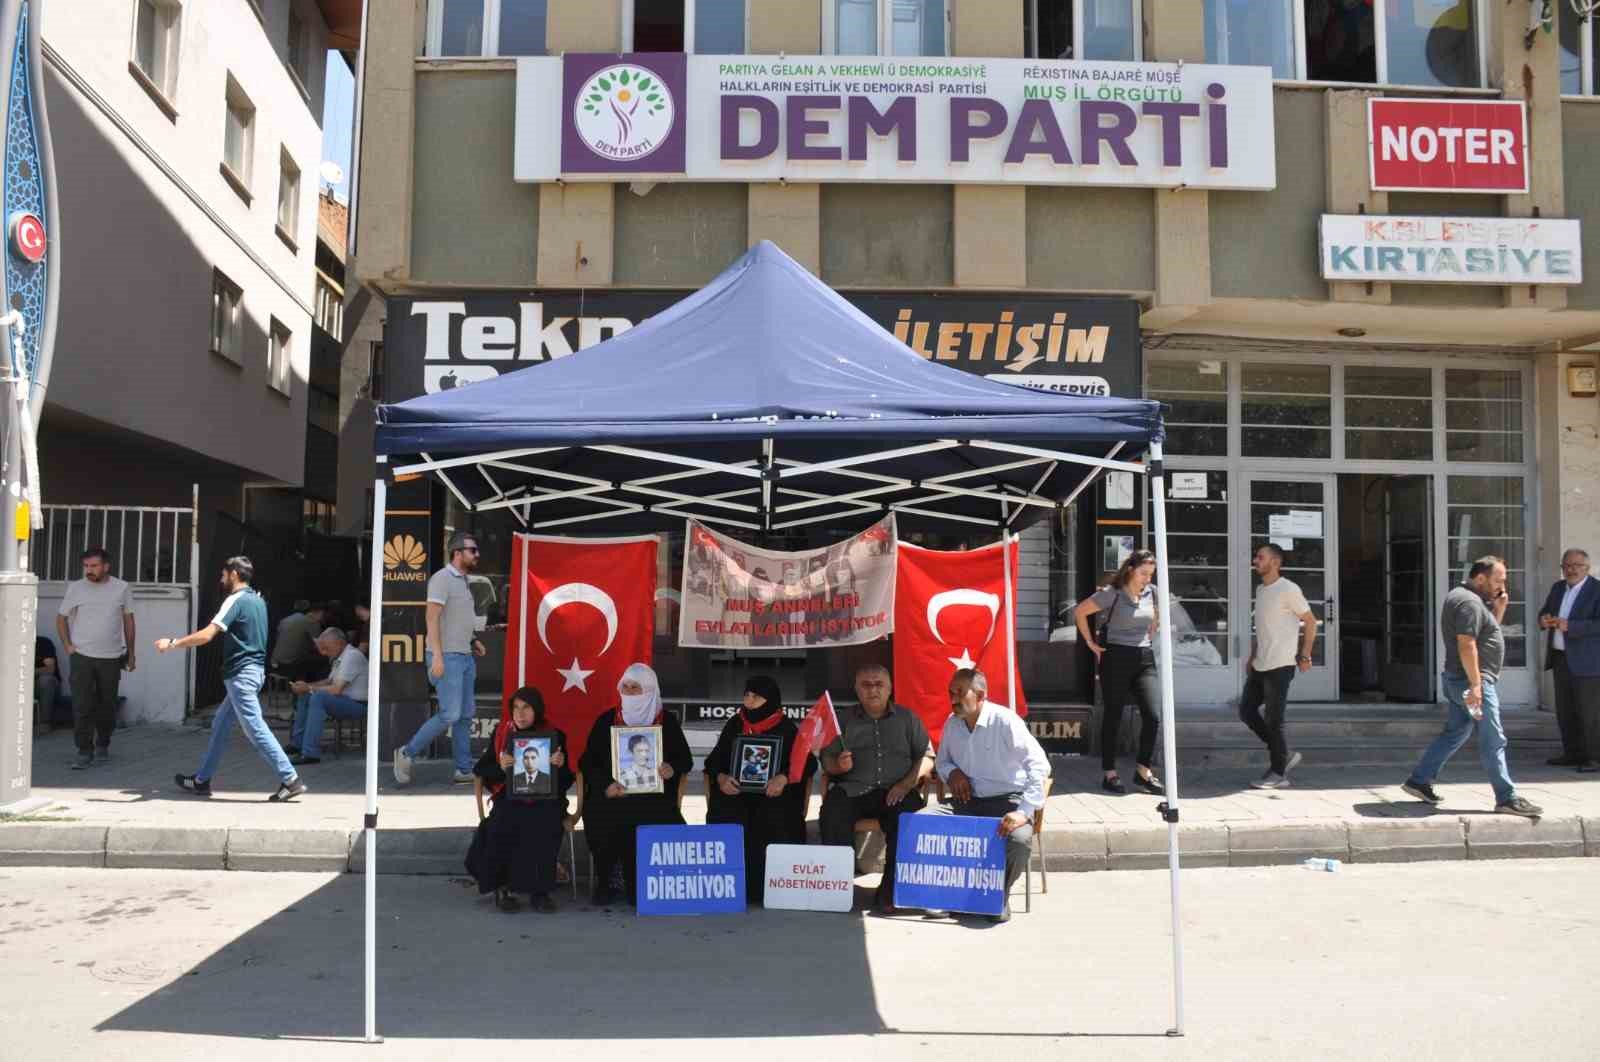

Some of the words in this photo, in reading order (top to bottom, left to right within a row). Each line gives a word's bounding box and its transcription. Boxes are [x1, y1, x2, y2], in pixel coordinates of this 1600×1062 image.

[771, 64, 814, 76] GELAN
[817, 65, 827, 76] A
[720, 81, 792, 93] HALKLARIN
[794, 80, 841, 94] EŞİTLİK
[844, 83, 860, 93] VE
[863, 81, 934, 94] DEMOKRASİ
[938, 82, 987, 95] PARTİSİ
[1023, 85, 1067, 102] MUŞ
[1074, 83, 1090, 100] İL
[1097, 83, 1183, 102] ÖRGÜTÜ
[720, 94, 917, 161] DEM
[949, 82, 1228, 168] PARTİ
[595, 139, 618, 156] DEM
[1381, 125, 1517, 164] NOTER
[1330, 244, 1574, 275] KIRTASİYE
[894, 308, 1110, 372] İLETİŞİM
[650, 841, 726, 866] ANNELER
[916, 833, 948, 856] ARTIK
[950, 835, 981, 859] YETER
[792, 863, 826, 875] EVLAT
[896, 862, 966, 889] YAKAMIZDAN
[968, 862, 1006, 896] DÜŞÜN
[646, 869, 737, 901] DİRENİYOR
[768, 875, 849, 892] NÖBETİNDEYİZ
